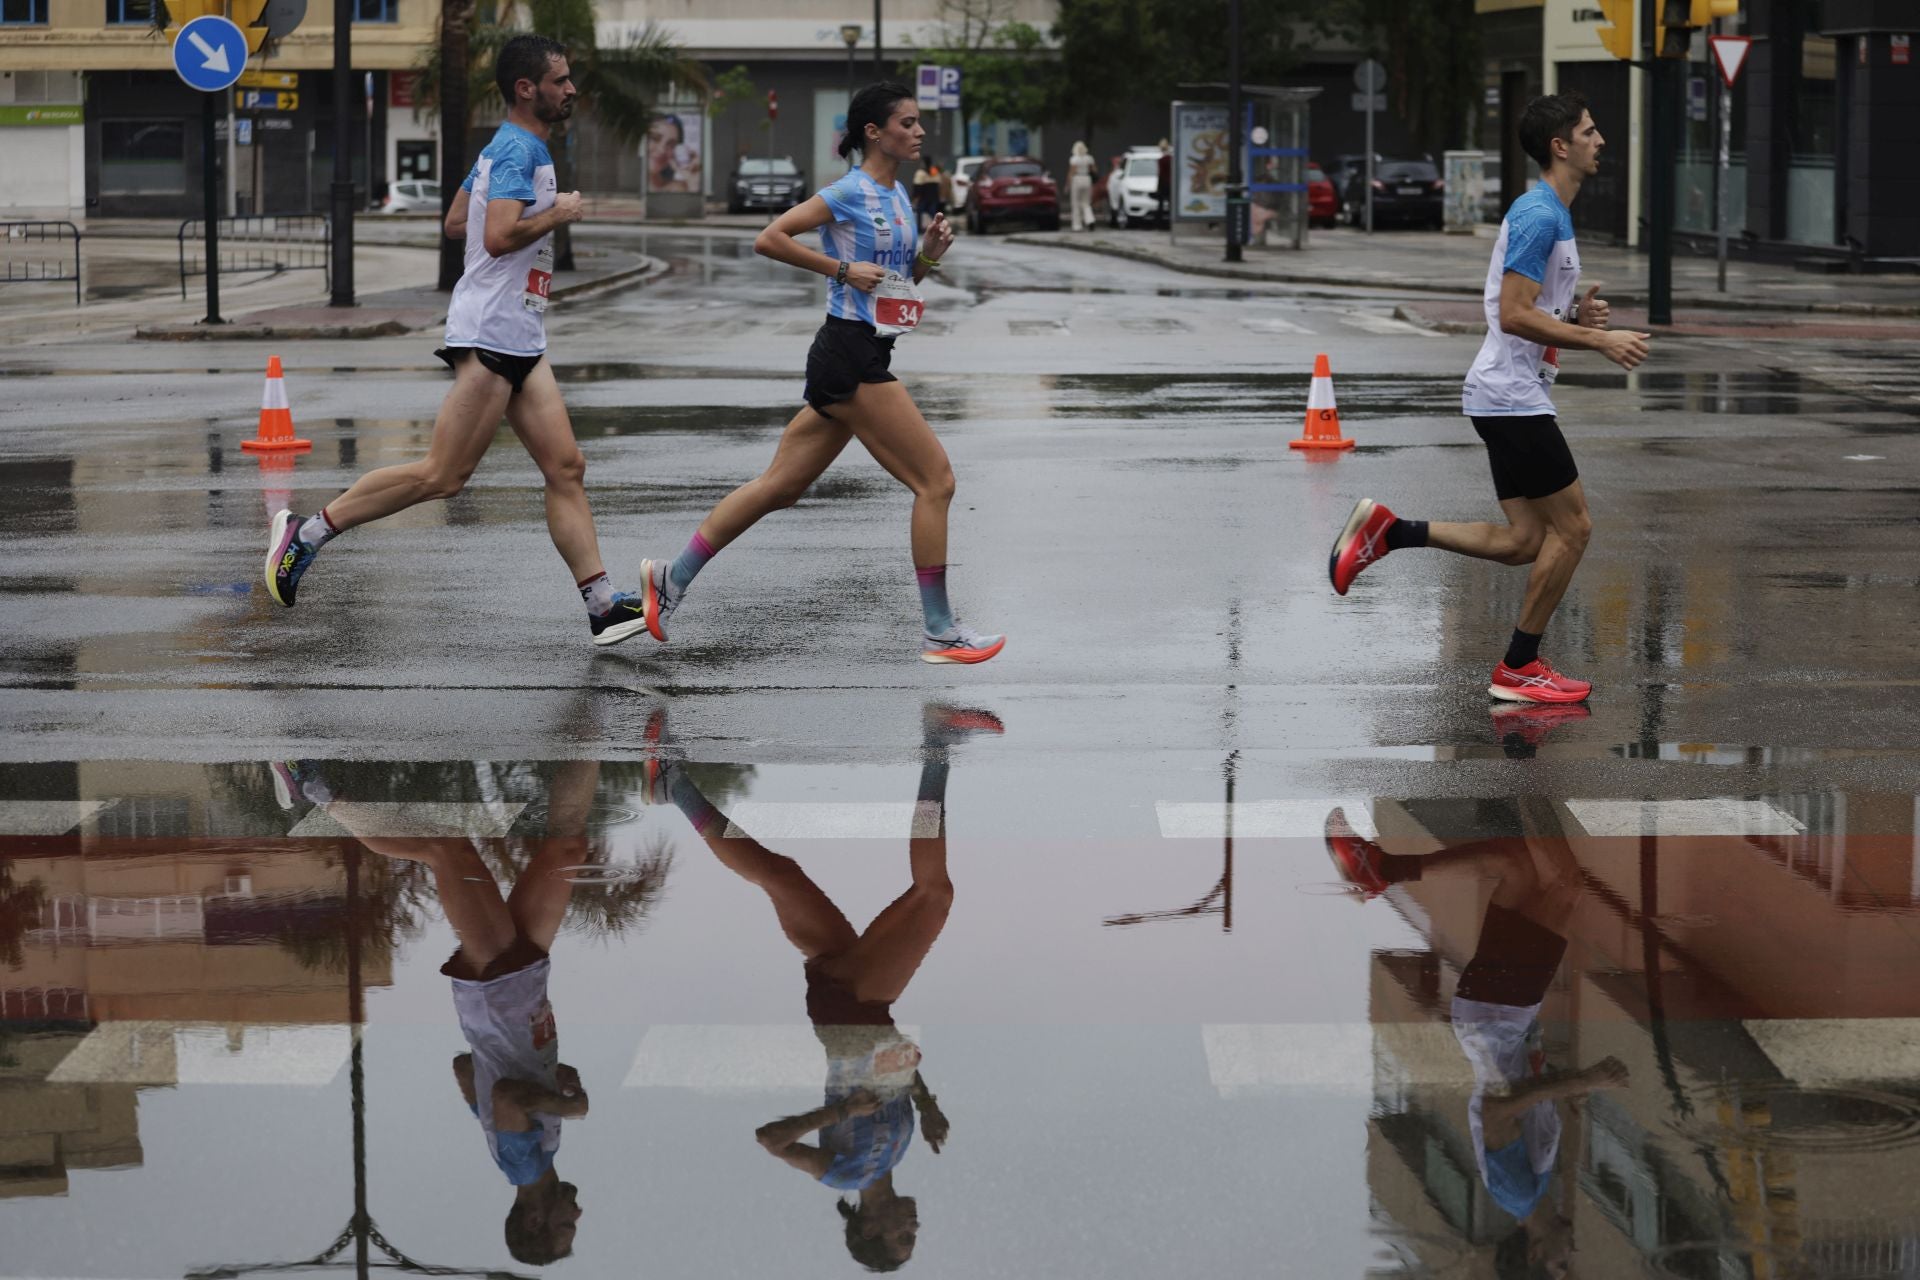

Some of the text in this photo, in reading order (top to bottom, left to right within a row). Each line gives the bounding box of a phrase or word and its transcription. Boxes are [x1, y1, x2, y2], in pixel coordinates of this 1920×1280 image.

[246, 91, 260, 109] P
[897, 304, 918, 325] 34
[277, 542, 300, 578] HOKA
